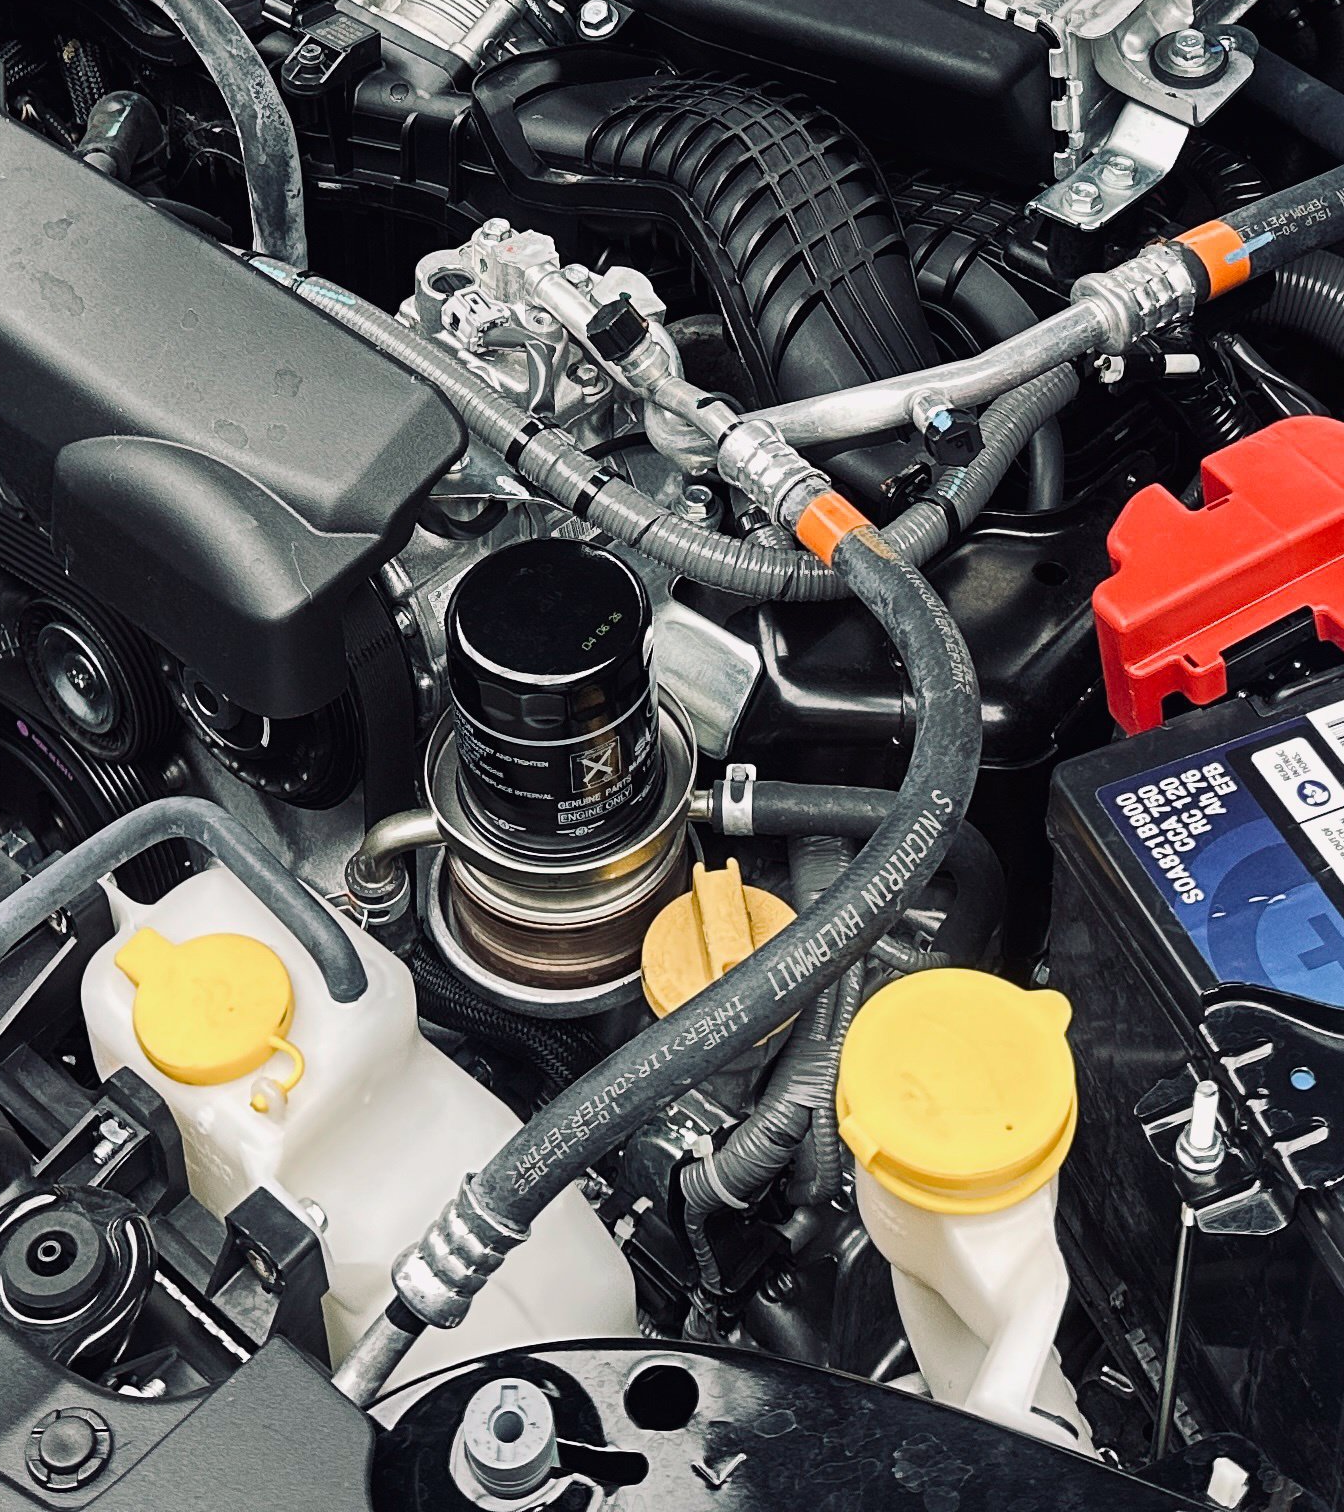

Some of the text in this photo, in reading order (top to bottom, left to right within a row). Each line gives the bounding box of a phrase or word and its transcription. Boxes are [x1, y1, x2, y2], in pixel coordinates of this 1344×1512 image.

[1202, 763, 1237, 795] EFB
[1274, 764, 1292, 781] READ
[558, 776, 631, 810] GENUINE PARTS
[560, 788, 631, 823] ENGINE ONLY
[1159, 777, 1212, 835] RC 120
[1180, 769, 1227, 814] Ah 76
[1138, 785, 1196, 852] CCA 750
[1321, 827, 1333, 836] OF
[1328, 837, 1344, 851] OUT
[769, 903, 864, 1000] HYLAMMIT
